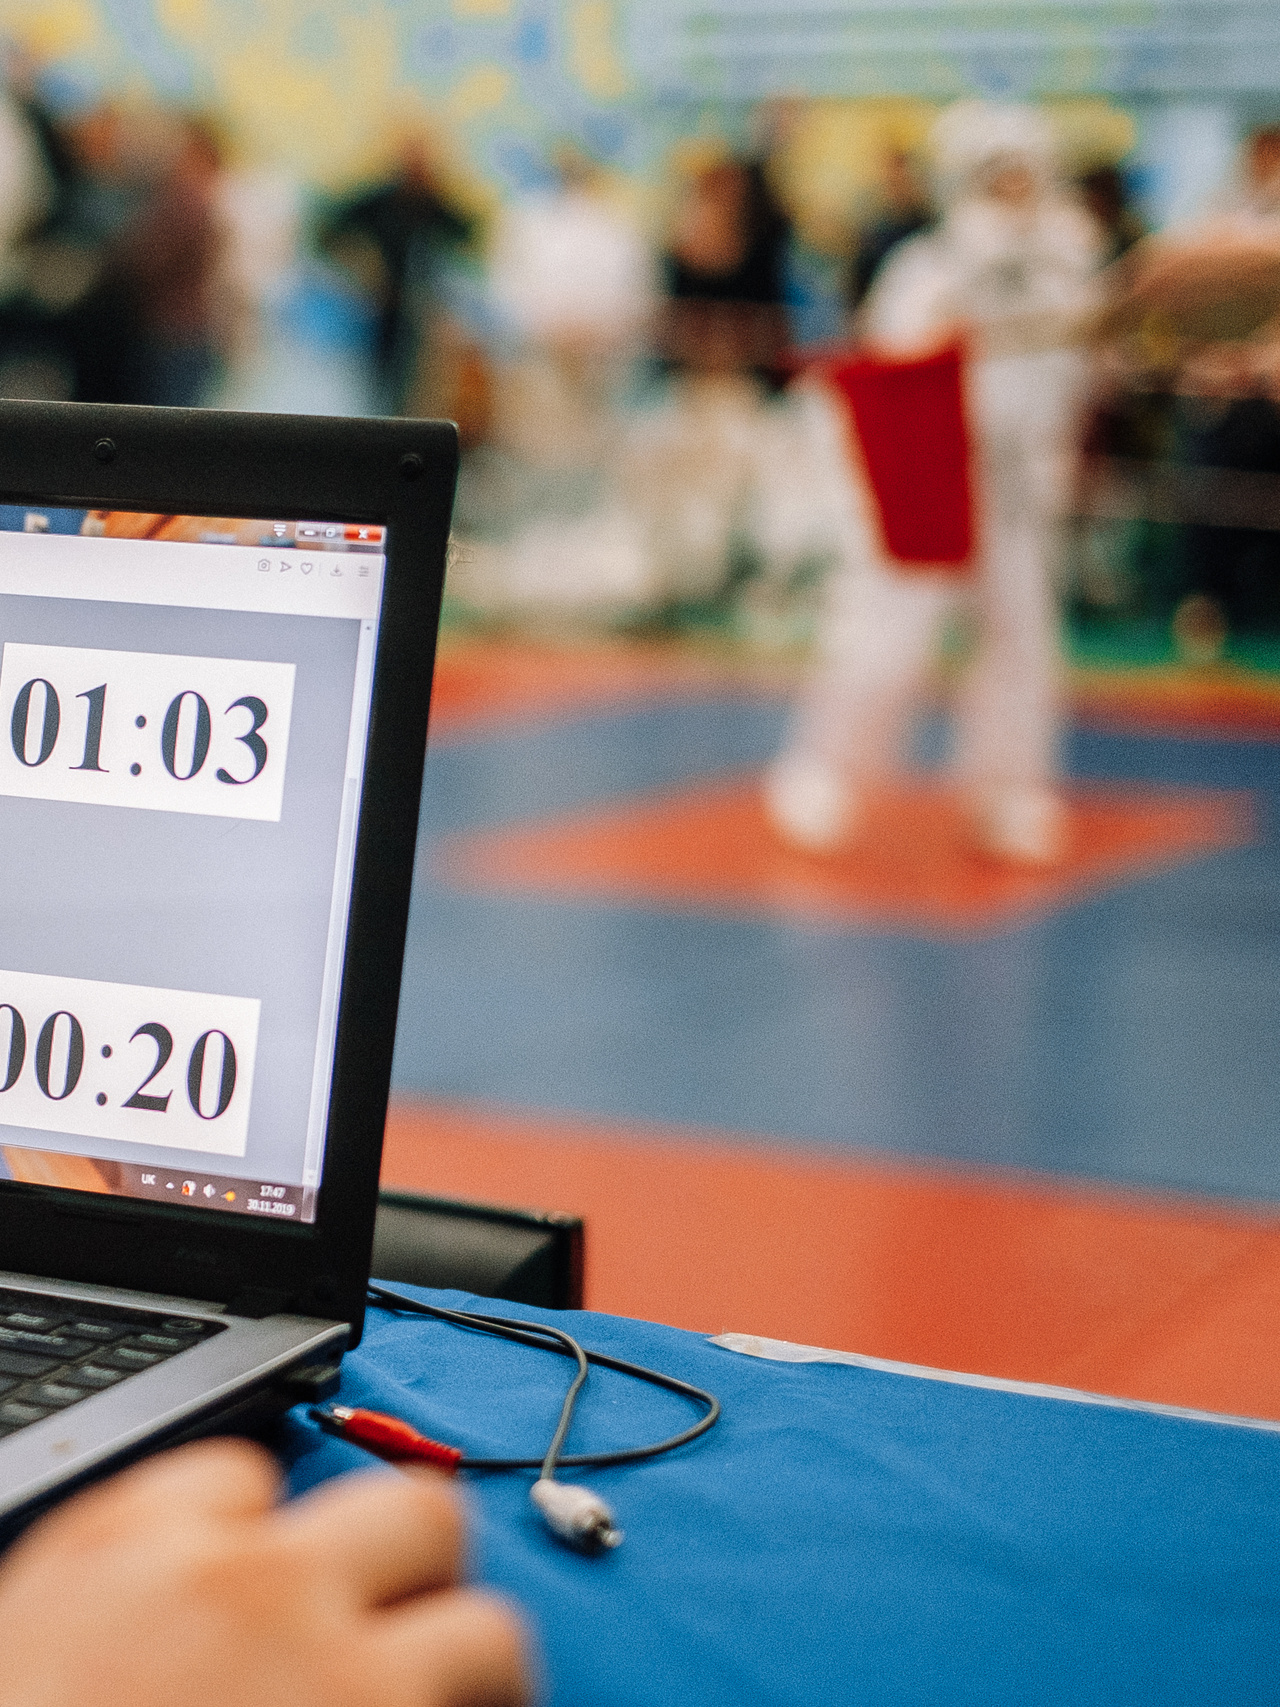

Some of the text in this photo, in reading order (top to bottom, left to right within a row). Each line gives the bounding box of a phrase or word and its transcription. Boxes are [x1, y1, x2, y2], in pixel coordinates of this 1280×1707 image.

[10, 677, 269, 785] 01:03
[141, 1174, 156, 1185] UK
[260, 1185, 287, 1198] 17:47
[247, 1198, 296, 1216] 30.11.2019
